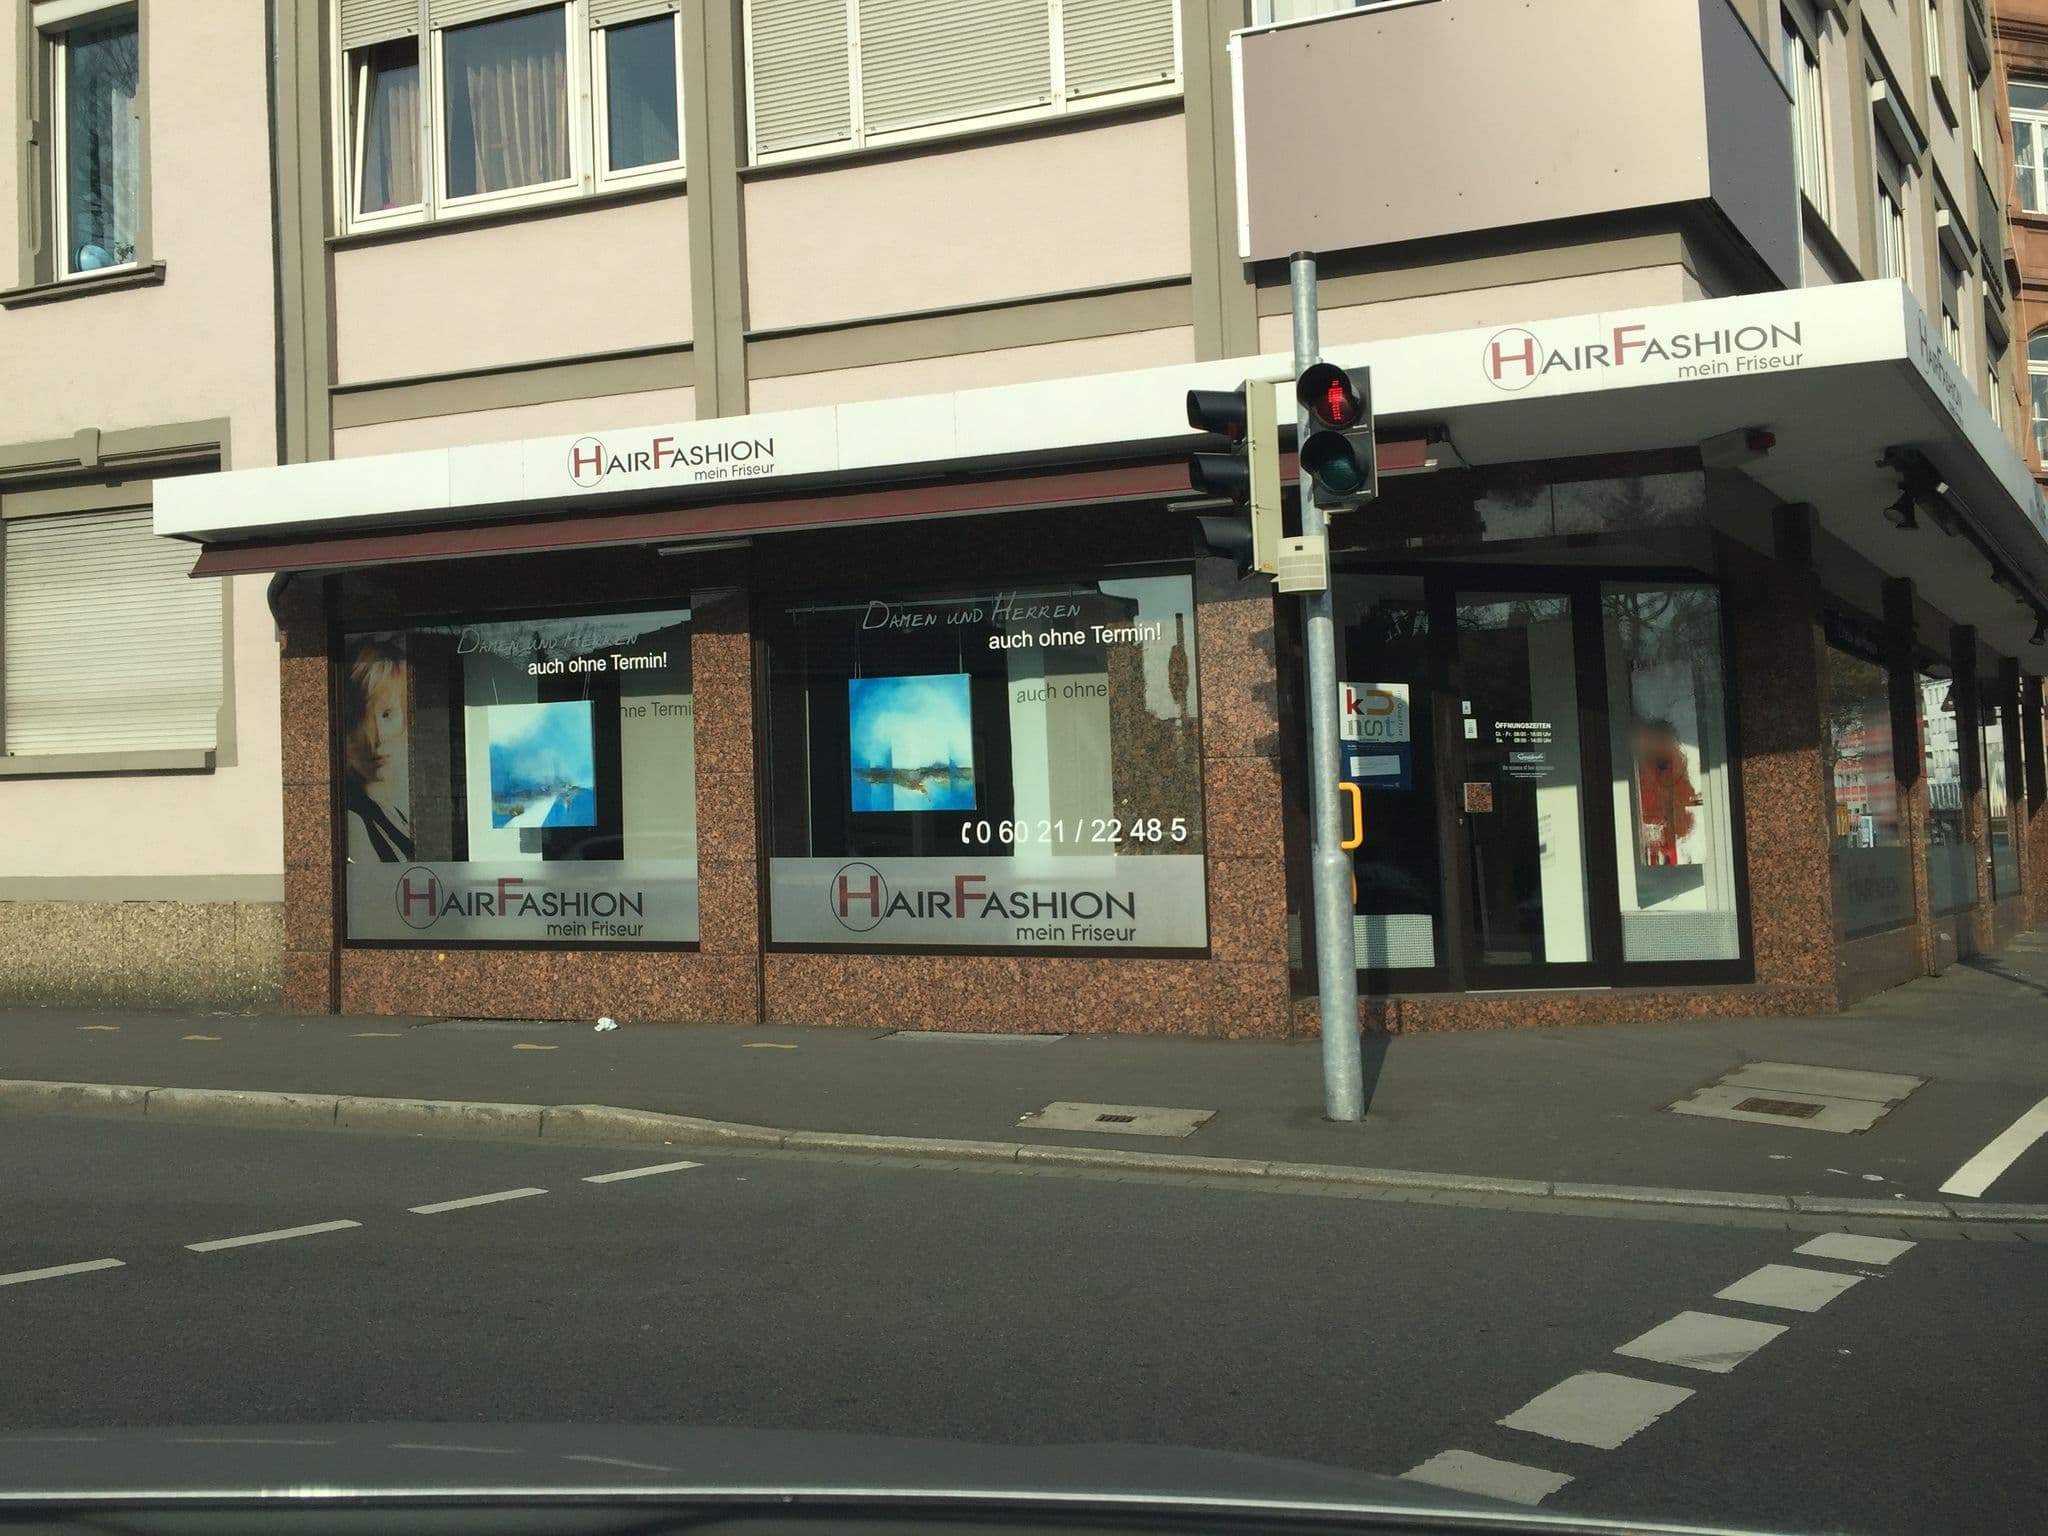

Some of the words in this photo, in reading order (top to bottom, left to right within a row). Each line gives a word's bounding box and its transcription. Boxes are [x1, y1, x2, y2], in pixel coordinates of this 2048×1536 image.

[1678, 357, 1729, 378] mein
[1736, 350, 1803, 373] Friseur
[694, 467, 728, 481] mein
[731, 462, 775, 479] Friseur
[861, 600, 937, 630] DAMEN
[947, 607, 984, 625] UND
[991, 591, 1081, 622] HERREN
[988, 629, 1033, 650] auch
[1039, 628, 1086, 648] ohne
[1090, 622, 1162, 645] Termin!
[528, 658, 564, 676] auch
[568, 655, 607, 674] ohne
[610, 651, 668, 671] Termin!
[1015, 681, 1058, 704] auch
[1062, 680, 1108, 699] ohne
[976, 820, 991, 844] 0
[998, 819, 1028, 844] 60
[1037, 818, 1065, 843] 21
[1074, 818, 1084, 843] /
[1091, 818, 1123, 843] 22
[1129, 817, 1162, 842] 48
[1170, 817, 1187, 842] 5
[546, 922, 588, 937] mein
[591, 920, 644, 938] Friseur
[1016, 925, 1064, 941] mein
[1071, 923, 1137, 942] Friseur
